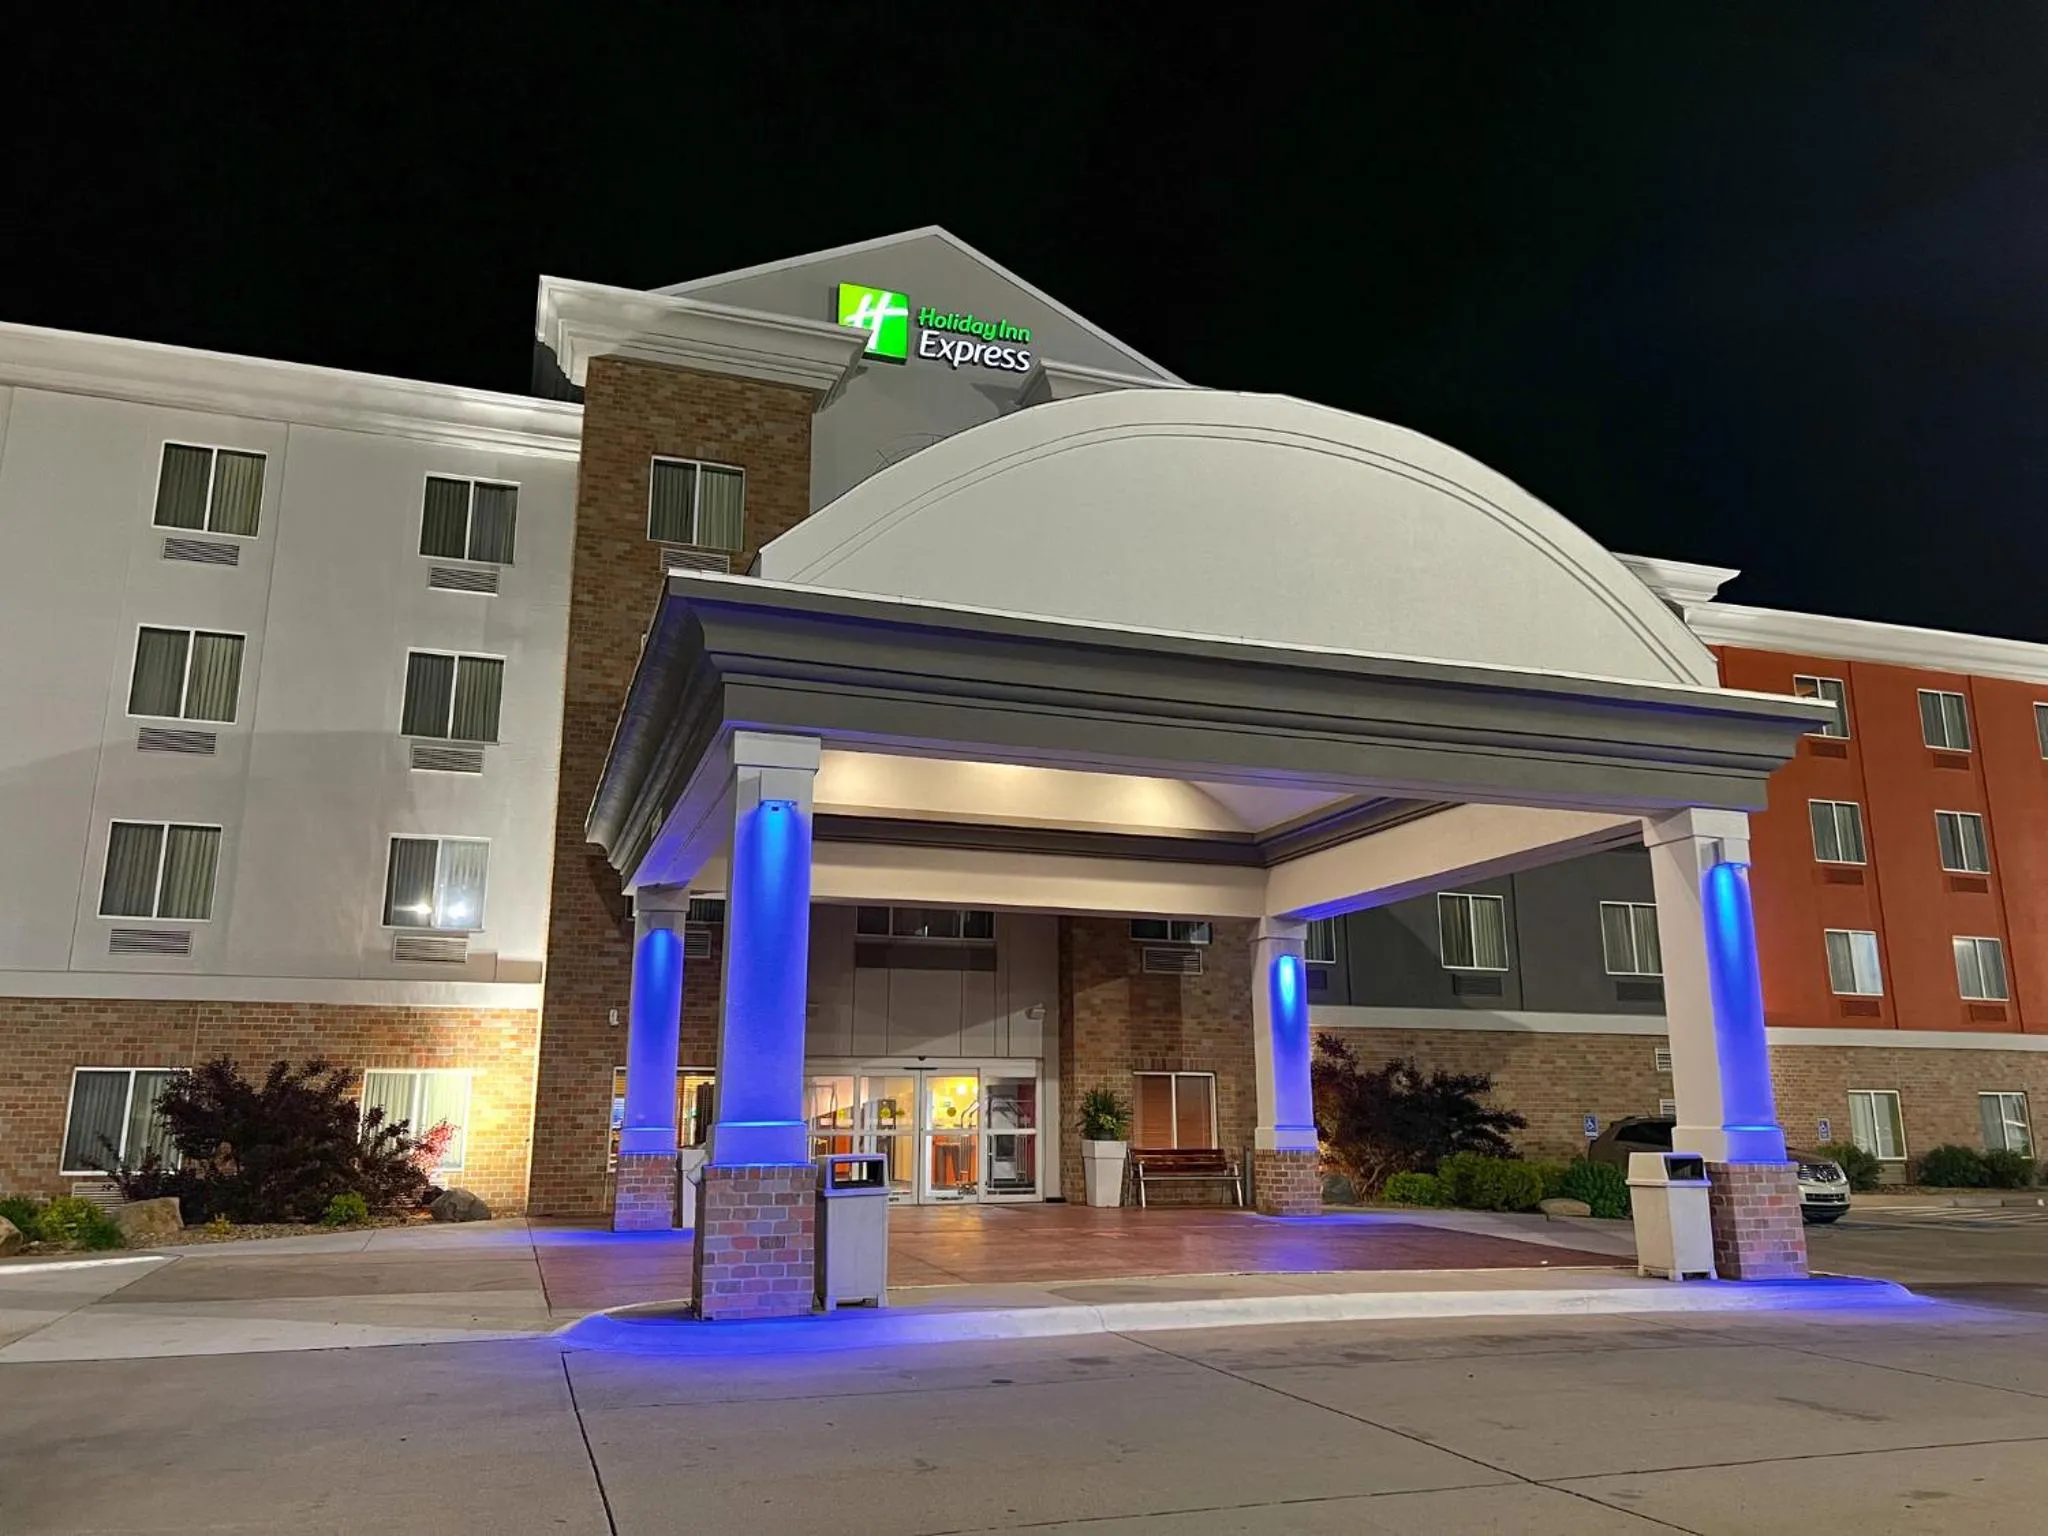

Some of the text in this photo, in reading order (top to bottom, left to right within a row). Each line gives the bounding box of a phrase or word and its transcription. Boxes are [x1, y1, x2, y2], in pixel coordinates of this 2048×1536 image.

[918, 306, 1031, 342] Holiday Inn
[919, 330, 1031, 371] Express
